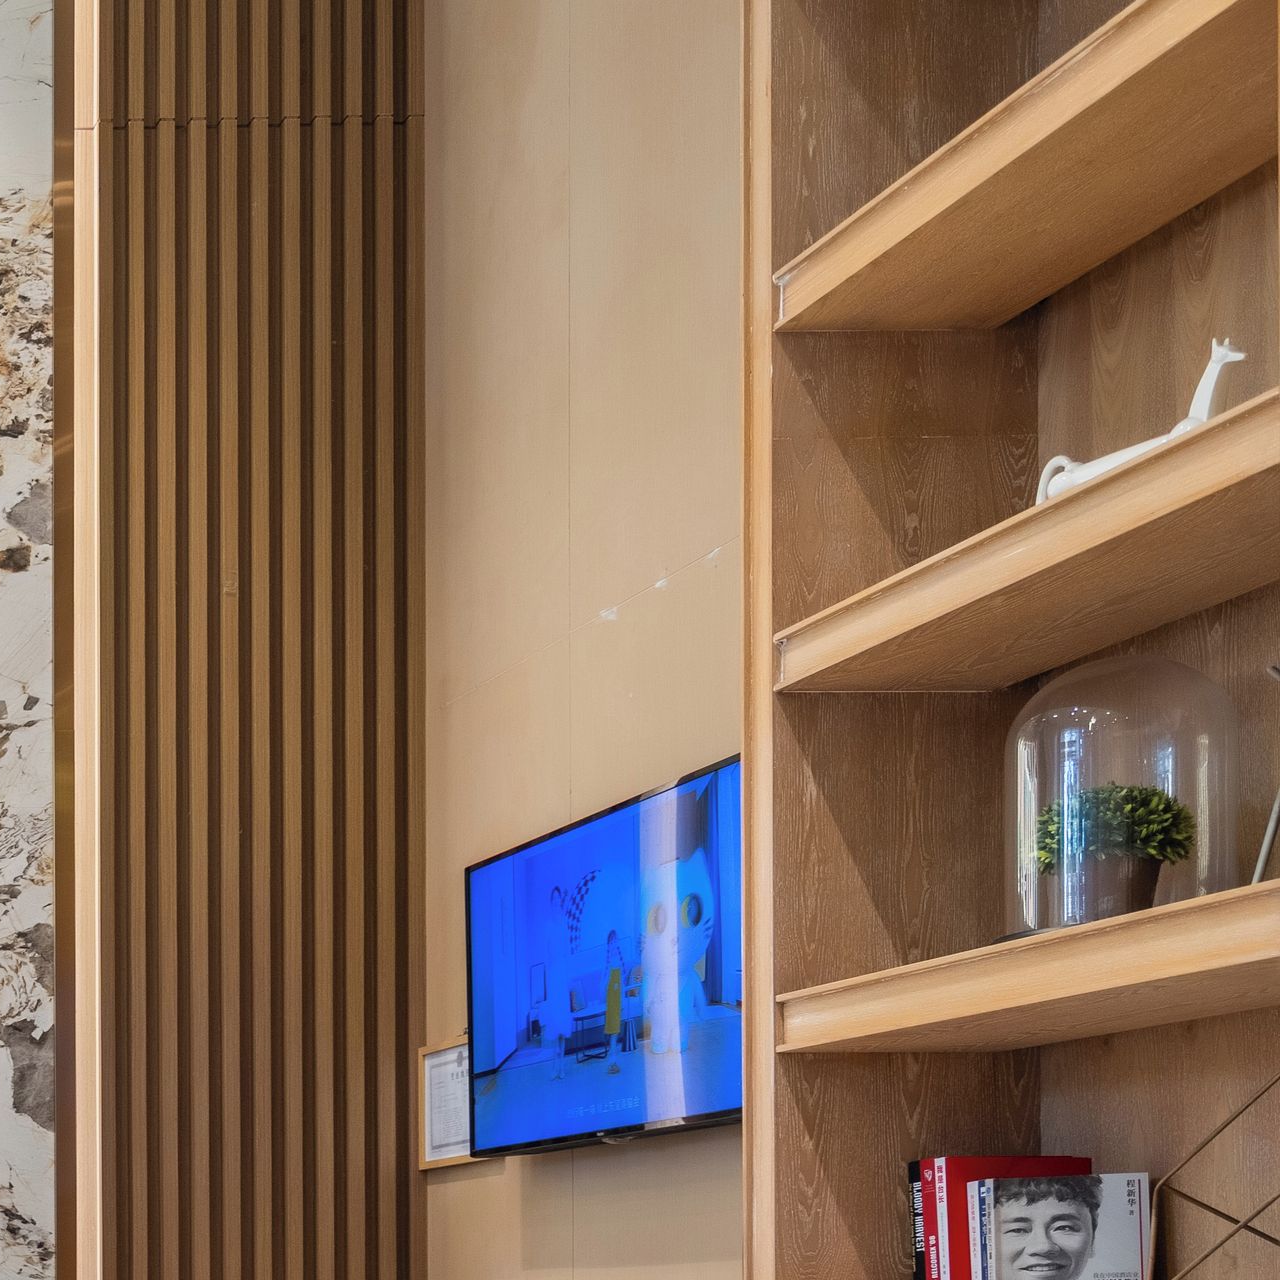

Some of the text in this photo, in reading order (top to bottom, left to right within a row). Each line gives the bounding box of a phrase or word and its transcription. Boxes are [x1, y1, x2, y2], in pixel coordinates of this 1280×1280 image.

[912, 1181, 923, 1213] BLOODY
[1126, 1179, 1137, 1207] 程新华
[914, 1215, 925, 1252] HARVEST
